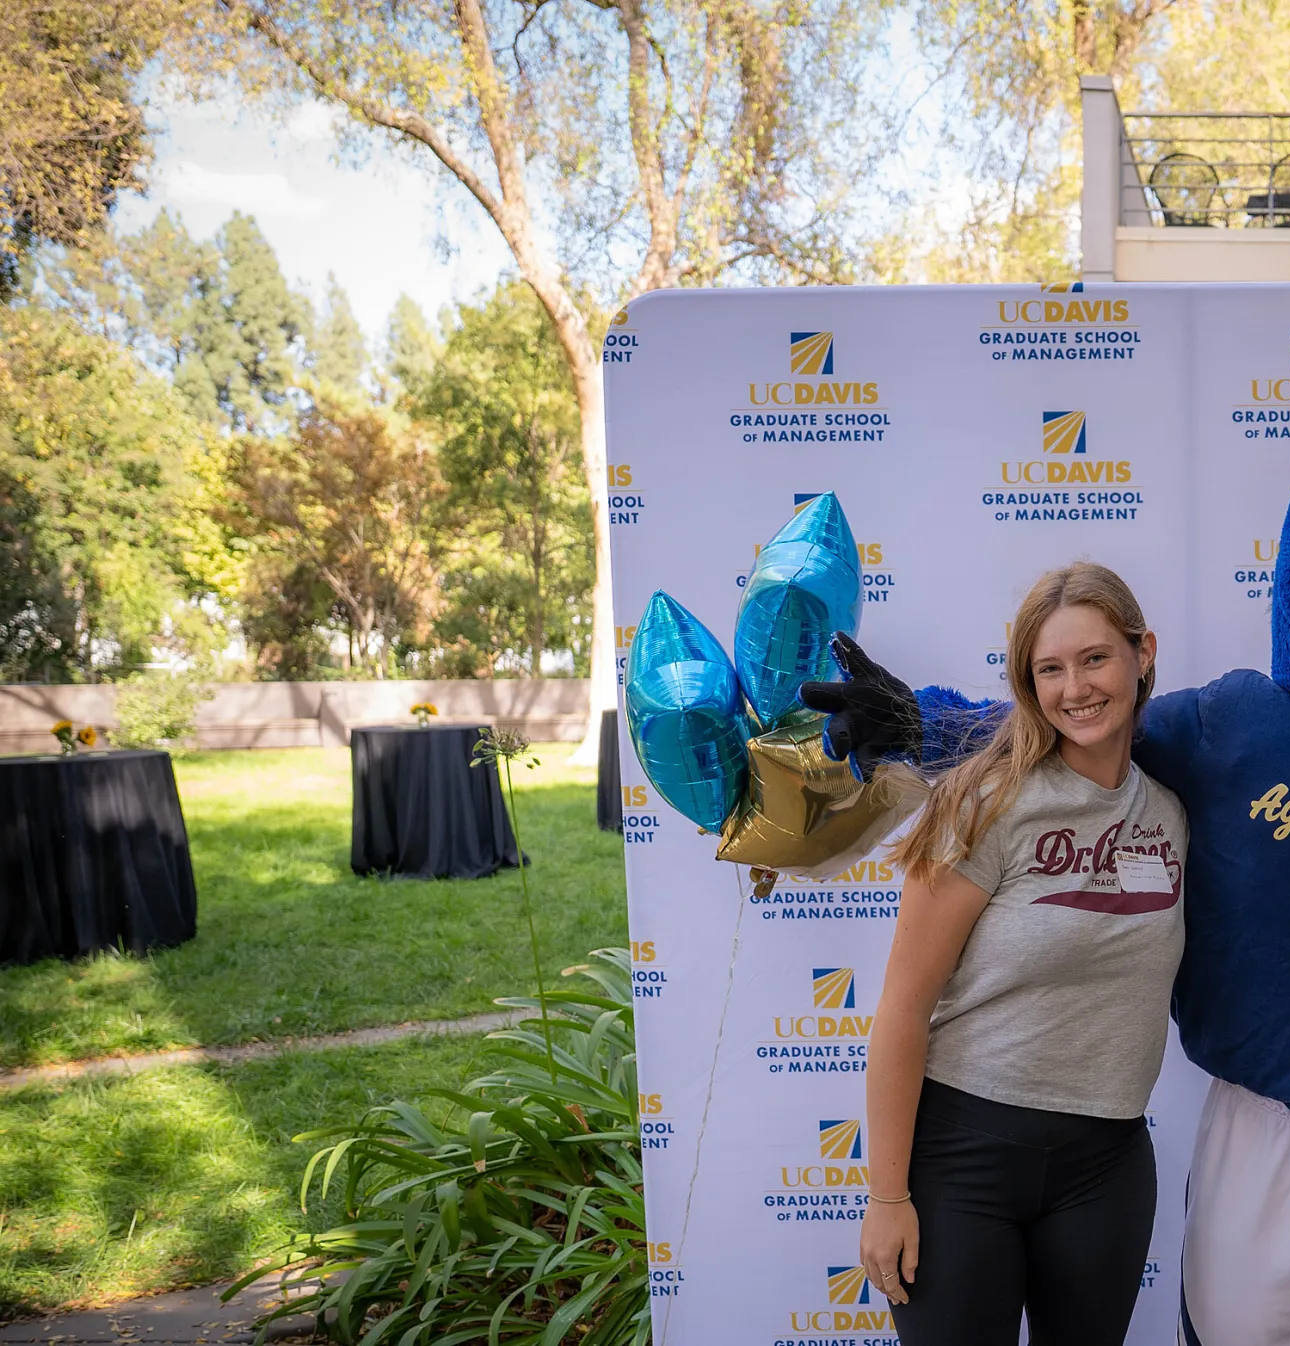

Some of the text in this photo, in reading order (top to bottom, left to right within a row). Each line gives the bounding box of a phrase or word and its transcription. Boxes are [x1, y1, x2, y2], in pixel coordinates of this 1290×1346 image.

[999, 300, 1129, 322] UCDAVIS
[980, 331, 1141, 344] GRADUATE SCHOOL
[992, 348, 1135, 360] OF MANAGEMENT
[750, 382, 879, 405] UCDAVIS
[730, 414, 891, 426] GRADUATE SCHOOL
[743, 430, 885, 442] OF MANAGEMENT
[1245, 430, 1260, 438] OF
[1002, 461, 1132, 484] UCDAVIS
[983, 492, 1144, 505] GRADUATE SCHOOL
[995, 508, 1138, 521] OF MANAGEMENT
[1248, 590, 1261, 598] OF
[1131, 823, 1165, 839] Drink
[1091, 879, 1117, 887] TRADE
[763, 907, 900, 919] OF MANAGEMENT
[775, 1016, 874, 1039] UCDAV
[757, 1046, 841, 1058] GRADUATE
[764, 1195, 848, 1206] GRADUATE
[777, 1213, 792, 1221] OF
